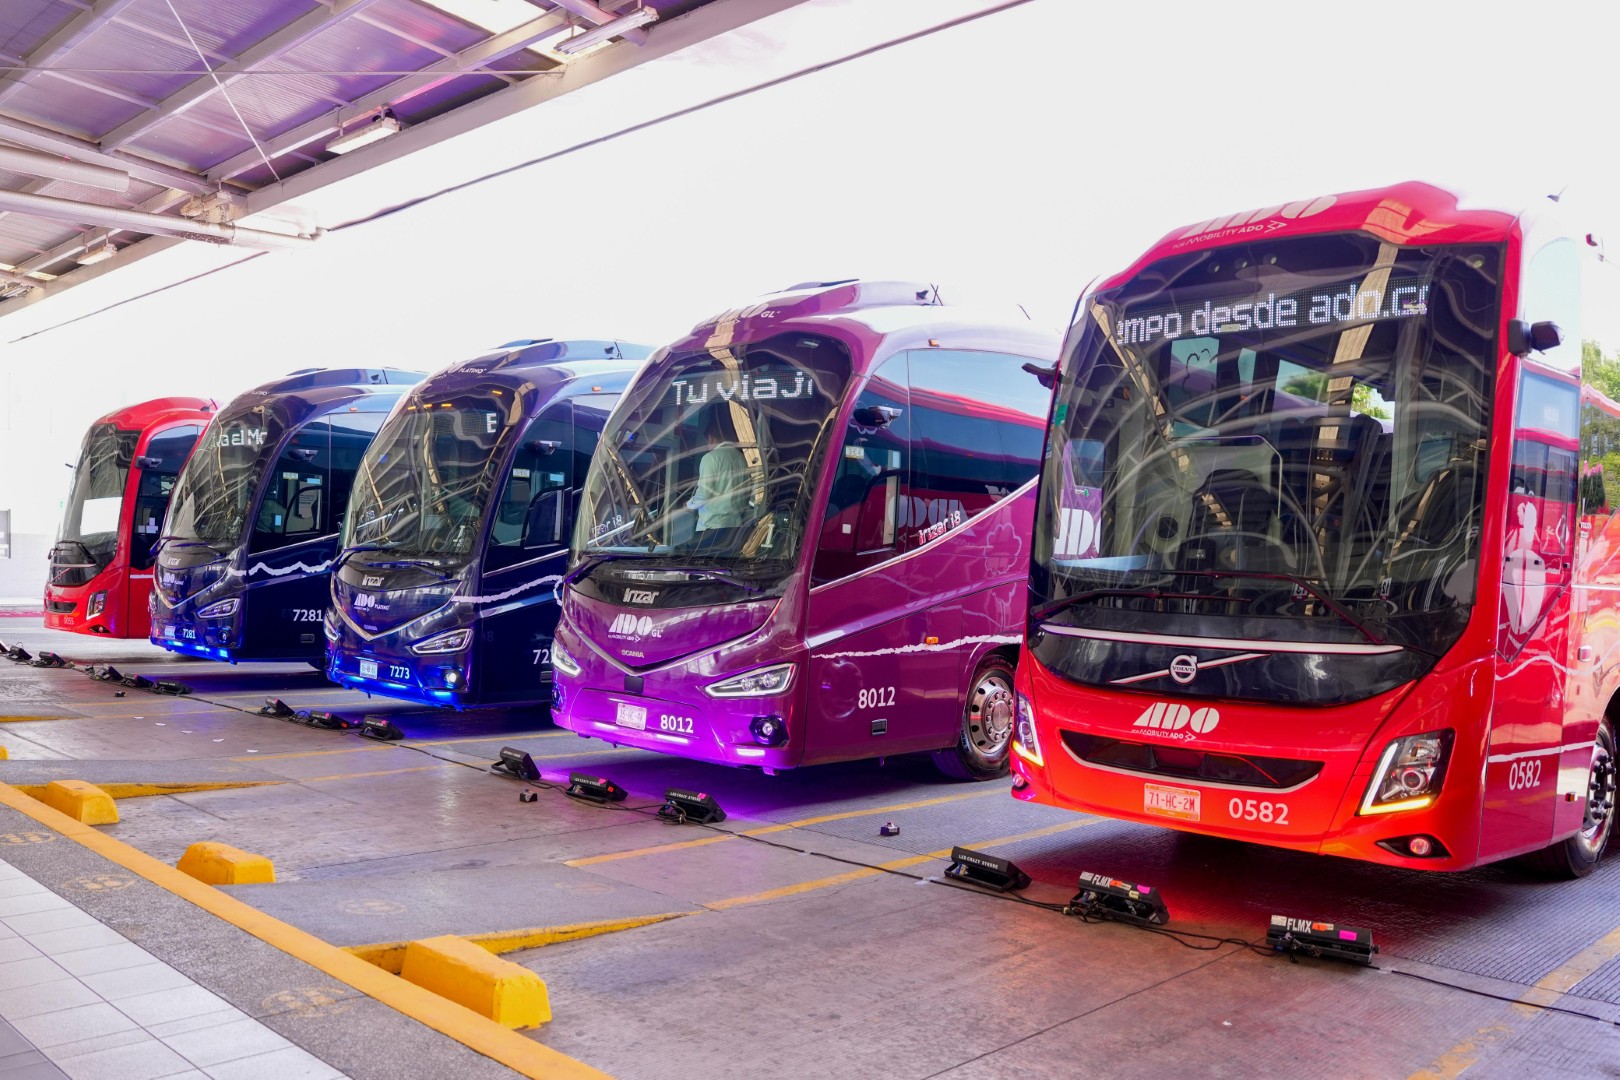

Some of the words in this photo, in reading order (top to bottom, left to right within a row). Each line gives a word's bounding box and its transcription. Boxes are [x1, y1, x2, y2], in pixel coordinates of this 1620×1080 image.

[1184, 228, 1238, 246] MOBILITY
[1238, 224, 1265, 234] ADO
[1191, 293, 1297, 336] desde
[672, 380, 708, 405] Tu
[486, 412, 497, 433] E
[354, 592, 375, 608] ADO
[292, 609, 323, 622] 7281
[608, 613, 653, 636] ADO
[621, 649, 645, 659] SCANIA
[389, 665, 410, 680] 7273
[1172, 664, 1195, 673] VOLVO
[858, 686, 896, 710] 8012
[660, 714, 694, 734] 8012
[1132, 701, 1220, 734] ADO
[1139, 729, 1170, 738] MOBILITY
[1508, 759, 1541, 791] 0582
[1149, 791, 1195, 812] 71-HC-2M
[1228, 797, 1289, 825] 0582
[1092, 874, 1114, 888] FLMX
[1286, 918, 1312, 934] FLMX
